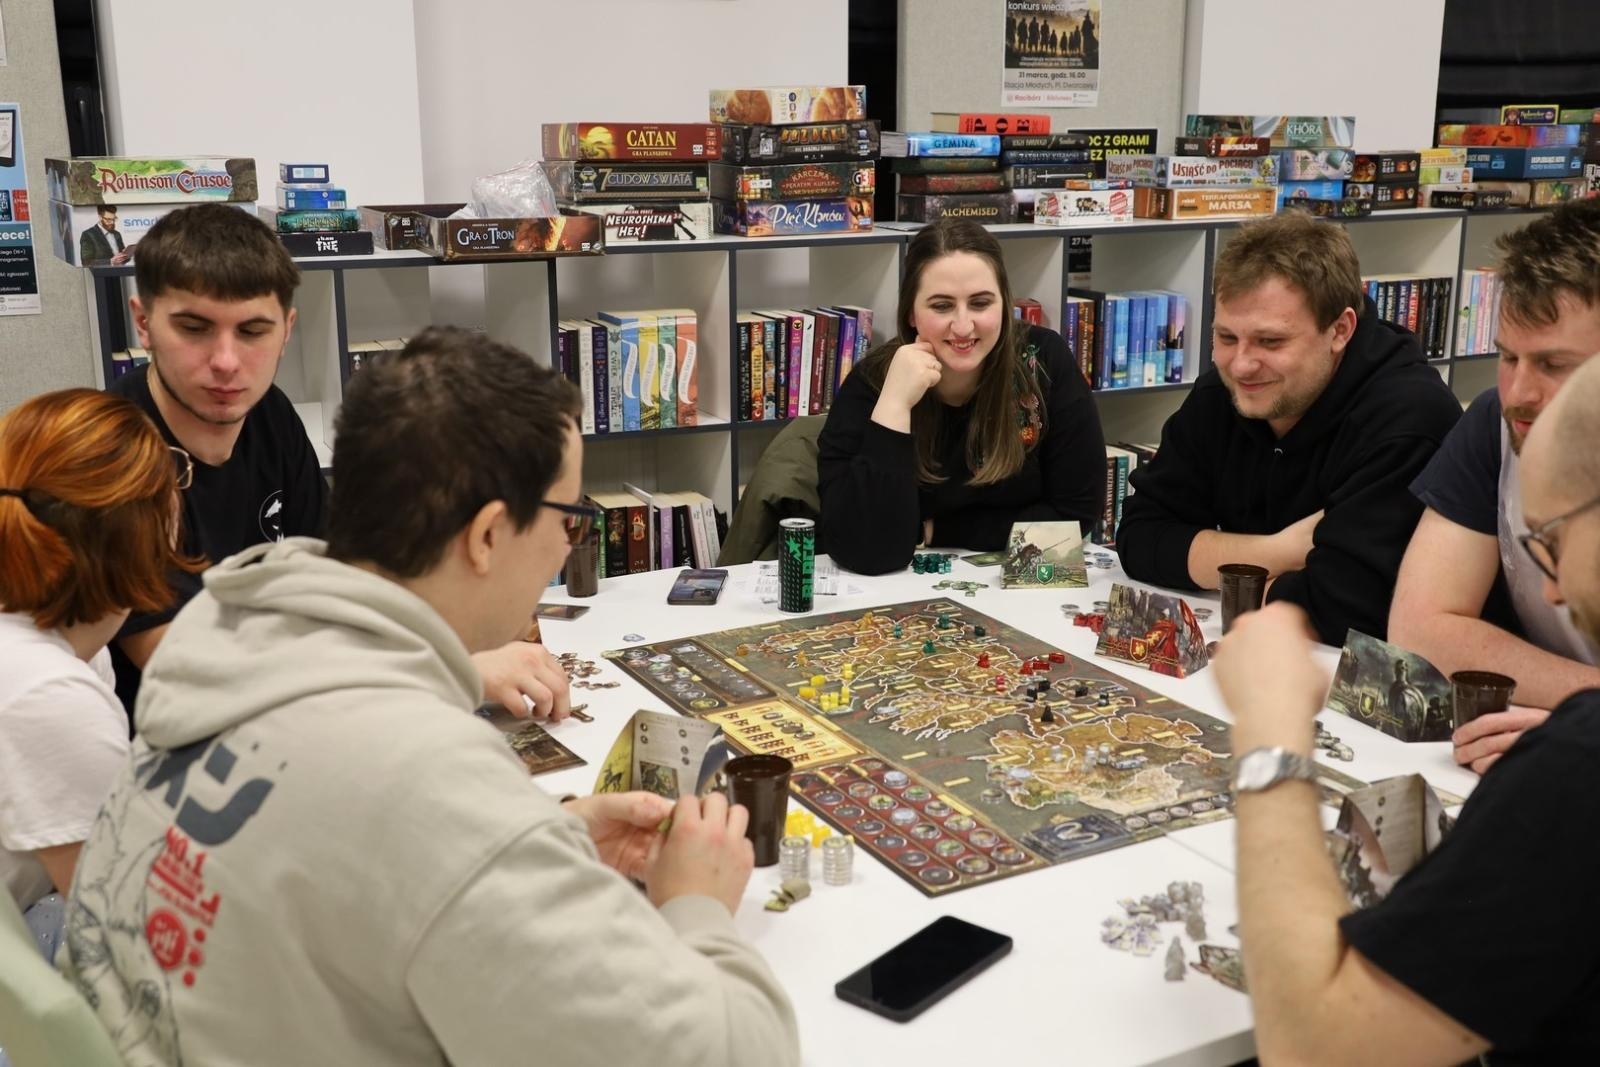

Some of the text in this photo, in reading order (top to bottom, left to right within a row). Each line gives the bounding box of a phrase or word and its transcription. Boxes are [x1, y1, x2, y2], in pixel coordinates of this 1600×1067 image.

[1008, 2, 1040, 11] konkurs
[626, 129, 677, 146] CATAN
[1105, 135, 1111, 146] Z
[1112, 135, 1150, 146] GRAMI
[934, 139, 976, 149] GEMINA
[1091, 149, 1103, 161] EZ
[1206, 165, 1217, 174] DO
[98, 167, 232, 193] Robinson Crusoe
[598, 168, 613, 191] 7
[792, 170, 829, 181] KARCZMA
[1201, 192, 1260, 200] TERRAFORMACJA
[1209, 201, 1252, 210] MARSA
[941, 208, 999, 217] ALCHEMISED
[606, 214, 672, 226] NEUROSHIMA
[457, 228, 480, 245] GRA
[490, 227, 515, 244] TRON
[618, 225, 647, 238] HEX!
[1072, 238, 1081, 246] 27
